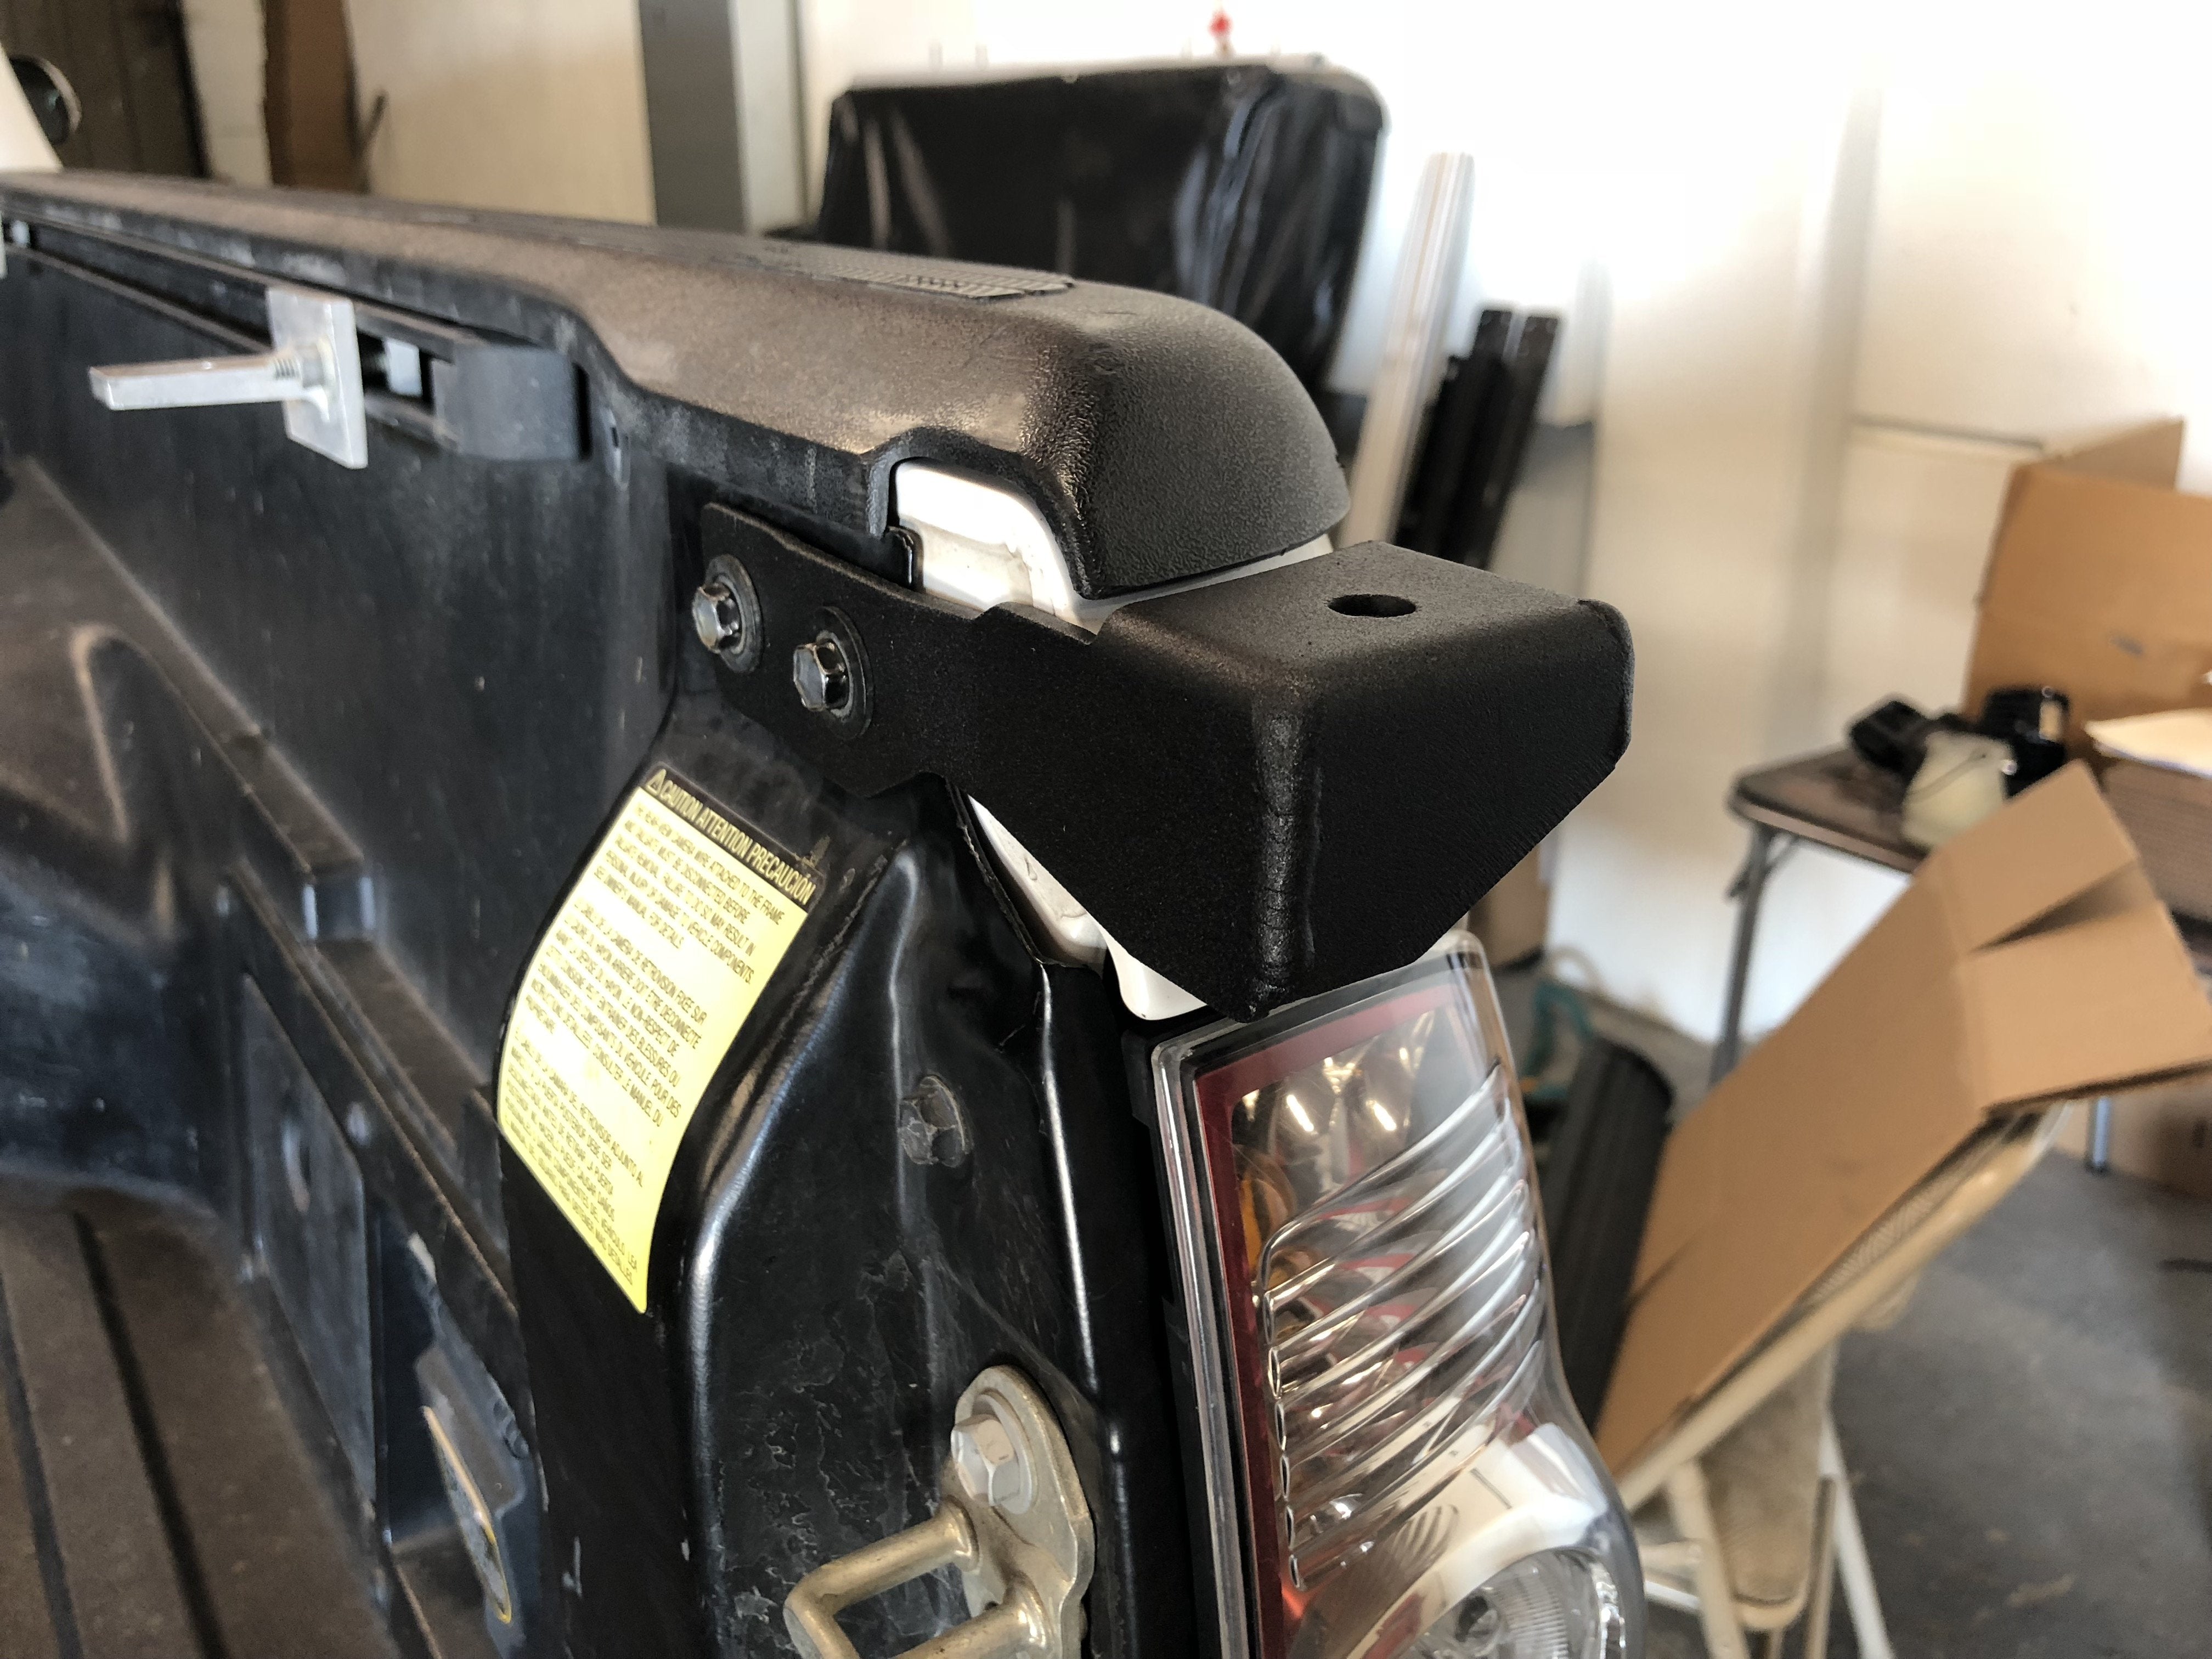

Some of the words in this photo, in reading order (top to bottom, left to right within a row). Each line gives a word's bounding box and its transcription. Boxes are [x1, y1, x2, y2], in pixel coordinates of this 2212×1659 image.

[658, 778, 704, 822] CAUTION
[696, 806, 754, 859] ATTENTION
[745, 842, 817, 905] PRECAUCIÓN
[680, 863, 726, 905] DISCONNECTED
[723, 896, 751, 924] BEFORE
[708, 860, 741, 890] ATTACHED
[737, 882, 751, 898] TO
[746, 889, 764, 909] THE
[759, 899, 785, 926] FRAME
[686, 918, 714, 947] VEHICLE
[709, 938, 757, 984] COMPONENTS.
[699, 904, 713, 920] SO
[709, 912, 725, 931] MAY
[722, 923, 748, 949] RESULT
[744, 941, 757, 957] IN
[628, 1002, 670, 1046] NON-RESPECT
[665, 1039, 681, 1057] DE
[689, 1005, 708, 1026] SUR
[624, 1025, 641, 1045] DES
[635, 1036, 673, 1078] BLESSURES
[667, 1069, 682, 1088] OU
[627, 1083, 657, 1118] MANUEL
[650, 1108, 666, 1128] DU
[648, 1078, 670, 1104] POUR
[664, 1096, 684, 1118] DES
[591, 1166, 615, 1196] PUERTA
[610, 1140, 639, 1177] ADJUNTO
[635, 1170, 647, 1188] AL
